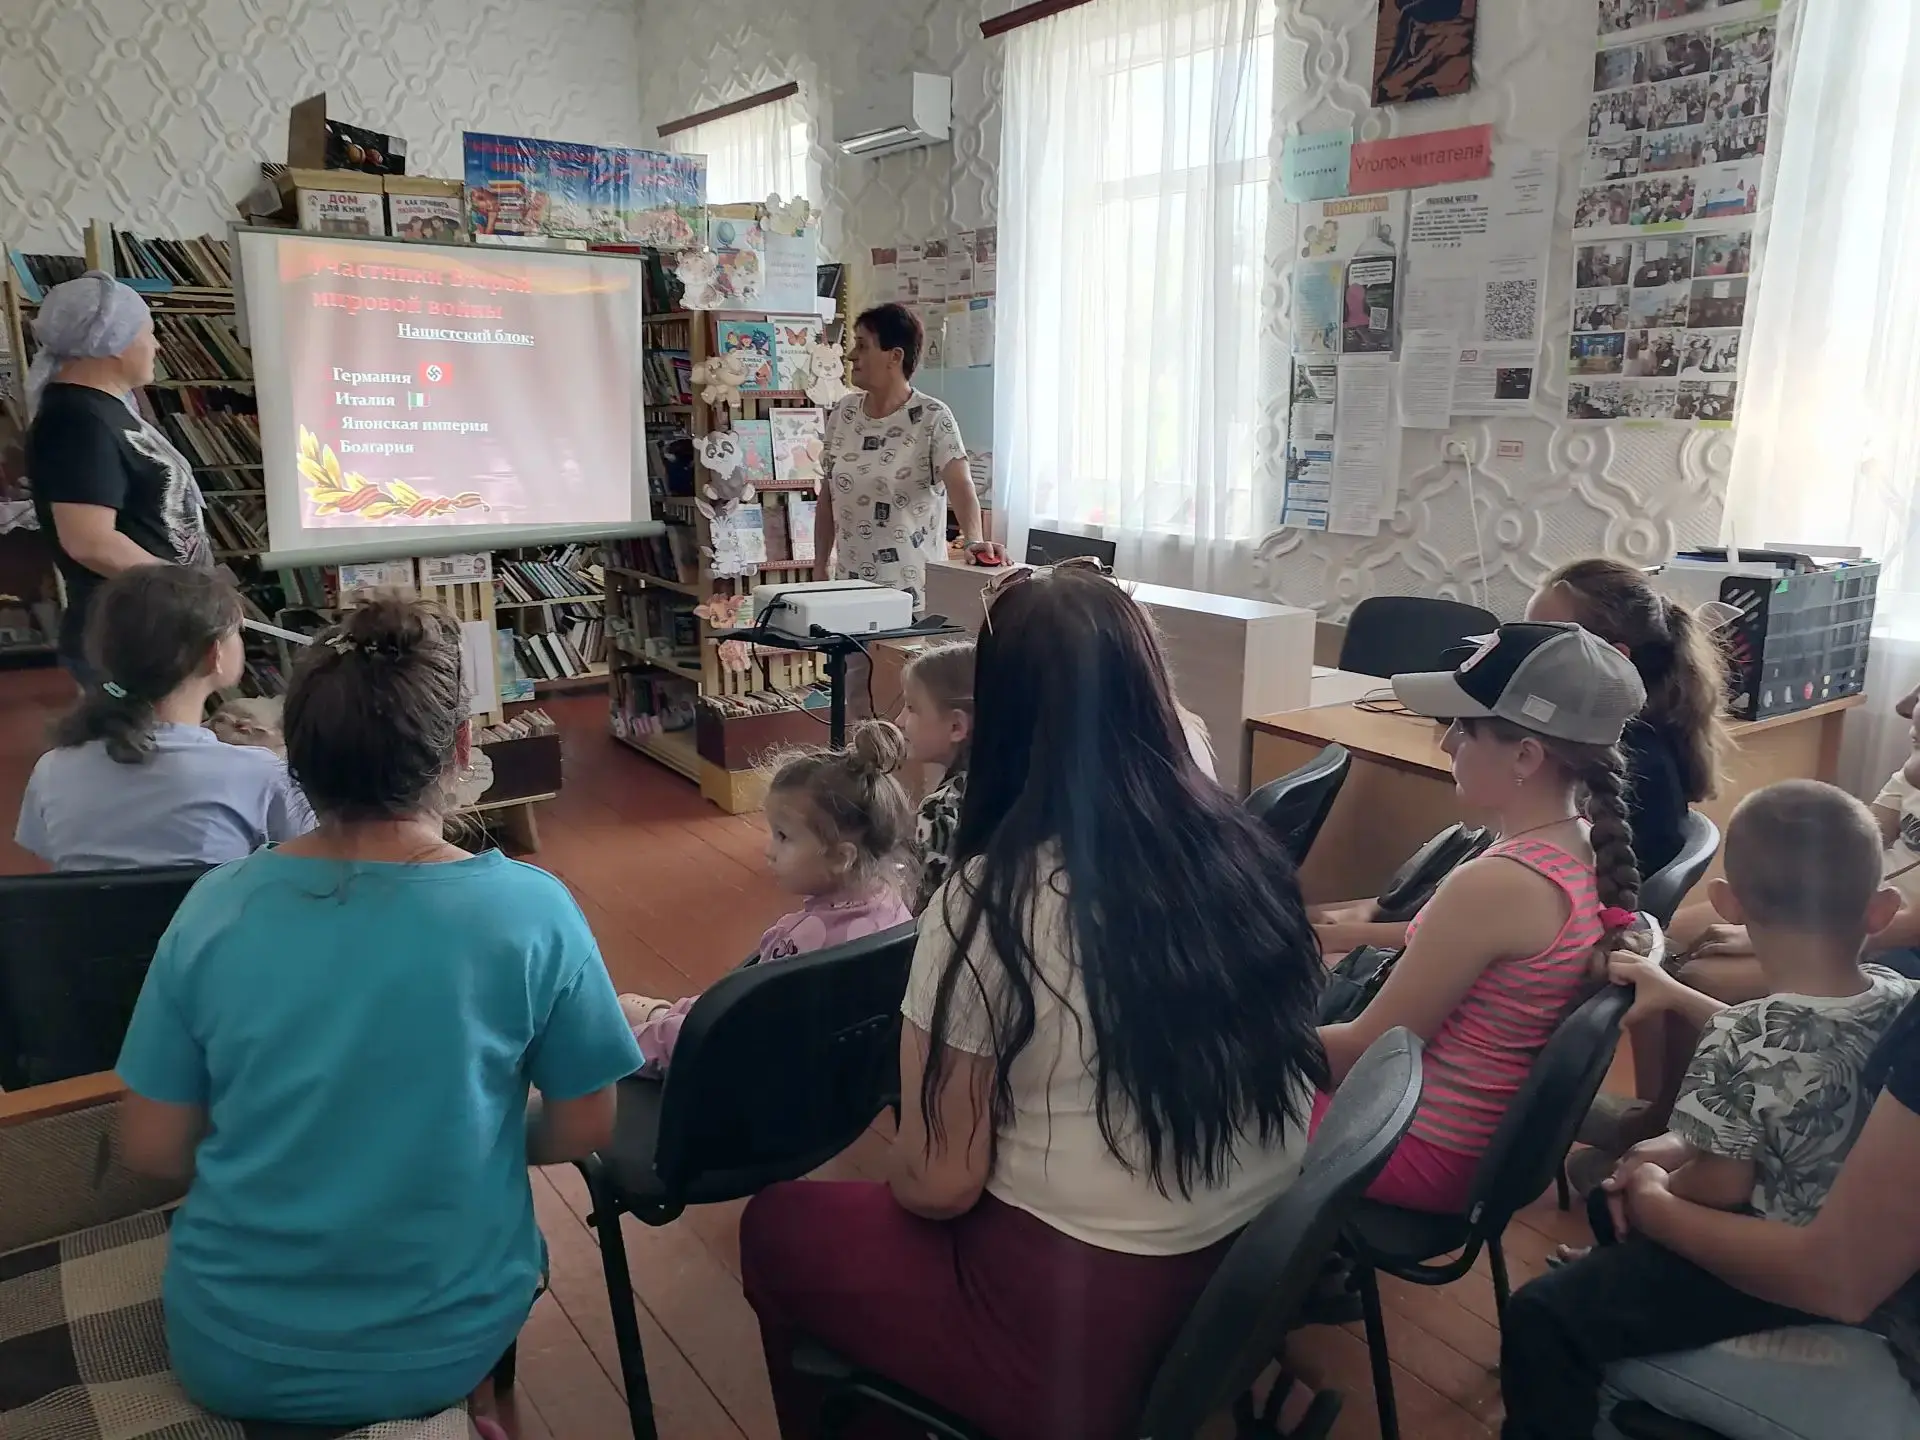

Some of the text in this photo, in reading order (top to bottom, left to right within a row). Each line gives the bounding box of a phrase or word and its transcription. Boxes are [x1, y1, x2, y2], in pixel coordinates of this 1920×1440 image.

[1356, 144, 1484, 172] Уголок читателя
[320, 203, 340, 212] ДЛЯ
[328, 194, 359, 204] ДОМ
[312, 291, 422, 316] мировой
[397, 322, 536, 346] Нацистский блок:
[332, 366, 412, 386] Германия
[335, 391, 396, 407] Италия
[342, 415, 489, 435] Японская империя
[339, 439, 414, 456] Болгария
